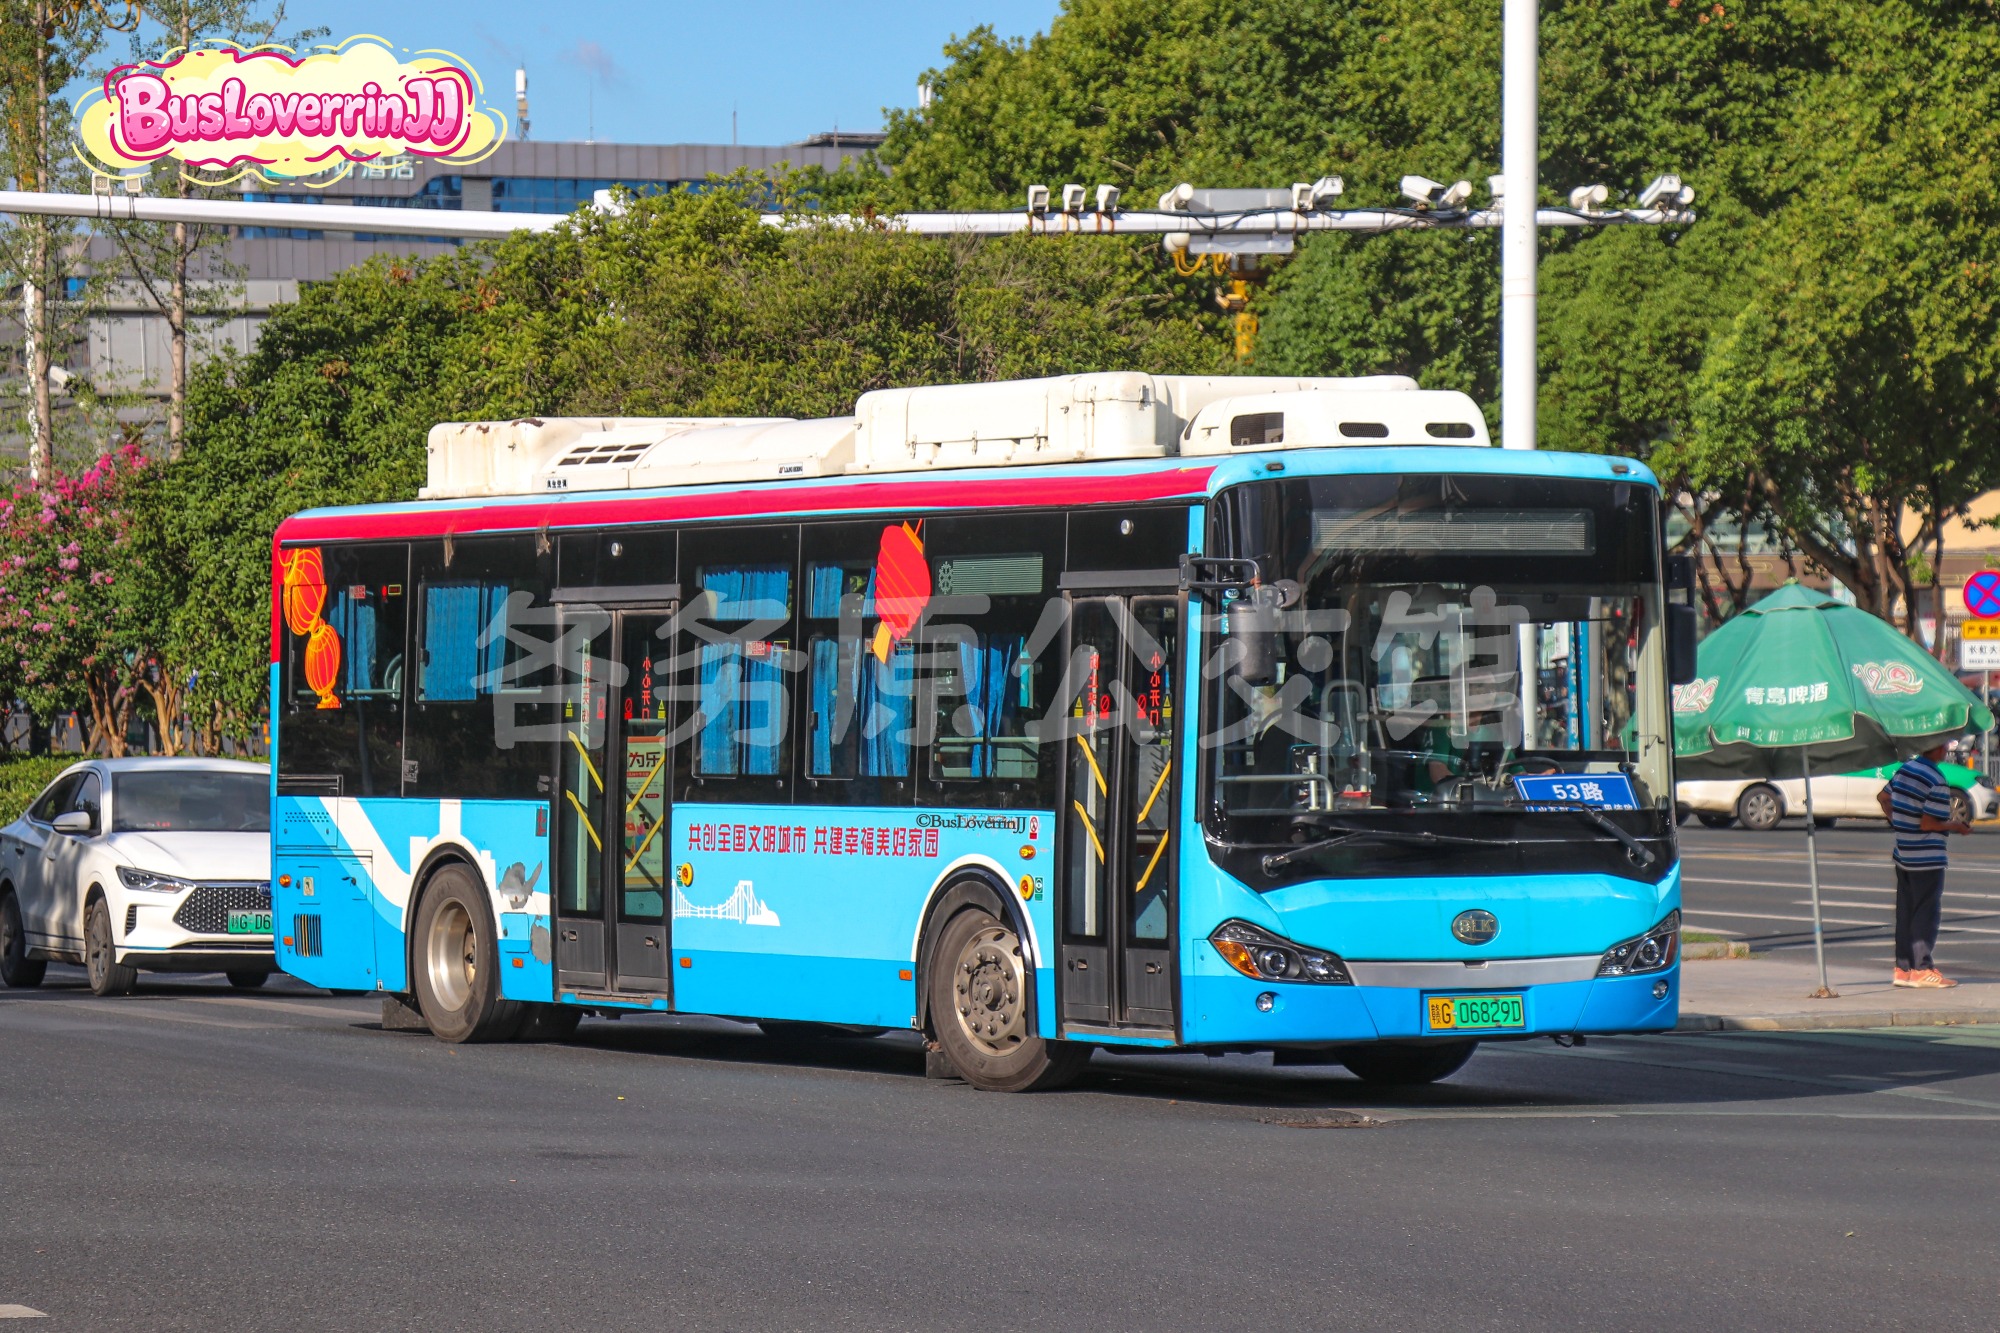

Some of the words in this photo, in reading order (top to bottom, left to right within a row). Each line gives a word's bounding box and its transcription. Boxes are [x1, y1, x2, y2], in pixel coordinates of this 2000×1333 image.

[1744, 681, 1829, 706] 青岛啤酒
[1551, 781, 1604, 801] 53路
[688, 823, 807, 853] 共创全国文明城市
[813, 826, 939, 857] 共建幸福美好家园
